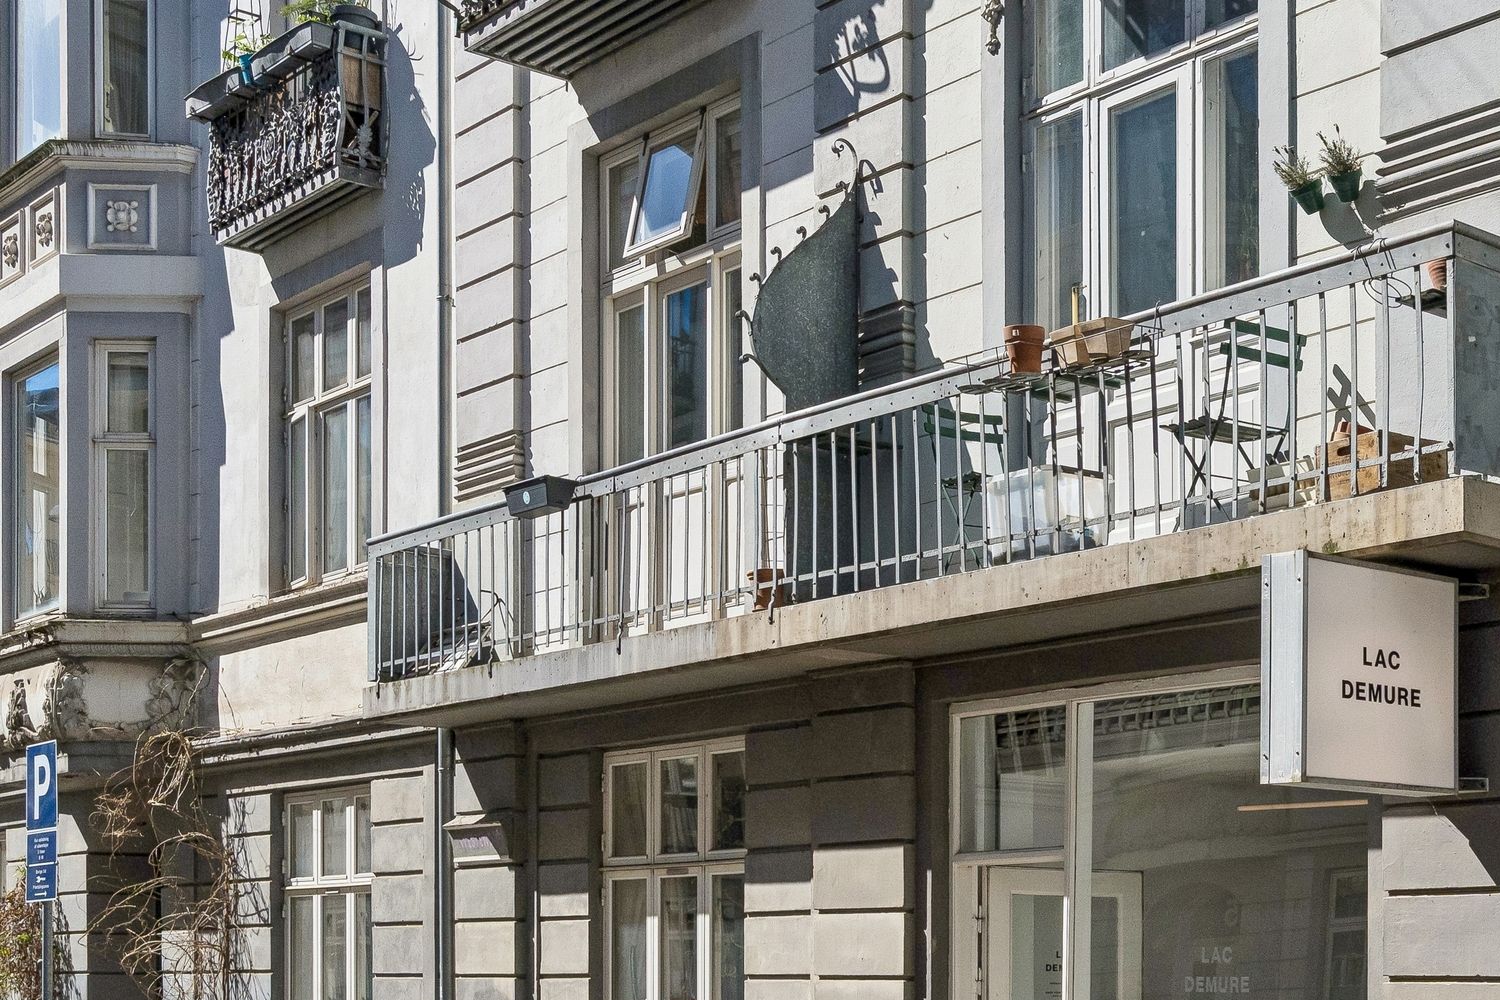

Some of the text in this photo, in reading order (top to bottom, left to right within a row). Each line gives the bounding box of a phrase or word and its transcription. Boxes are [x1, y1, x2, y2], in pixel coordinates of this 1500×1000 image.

[1362, 646, 1401, 670] LAC
[1341, 679, 1422, 708] DEMURE
[33, 754, 51, 820] P
[1201, 946, 1233, 964] LAC
[1184, 976, 1250, 993] DEMURE
